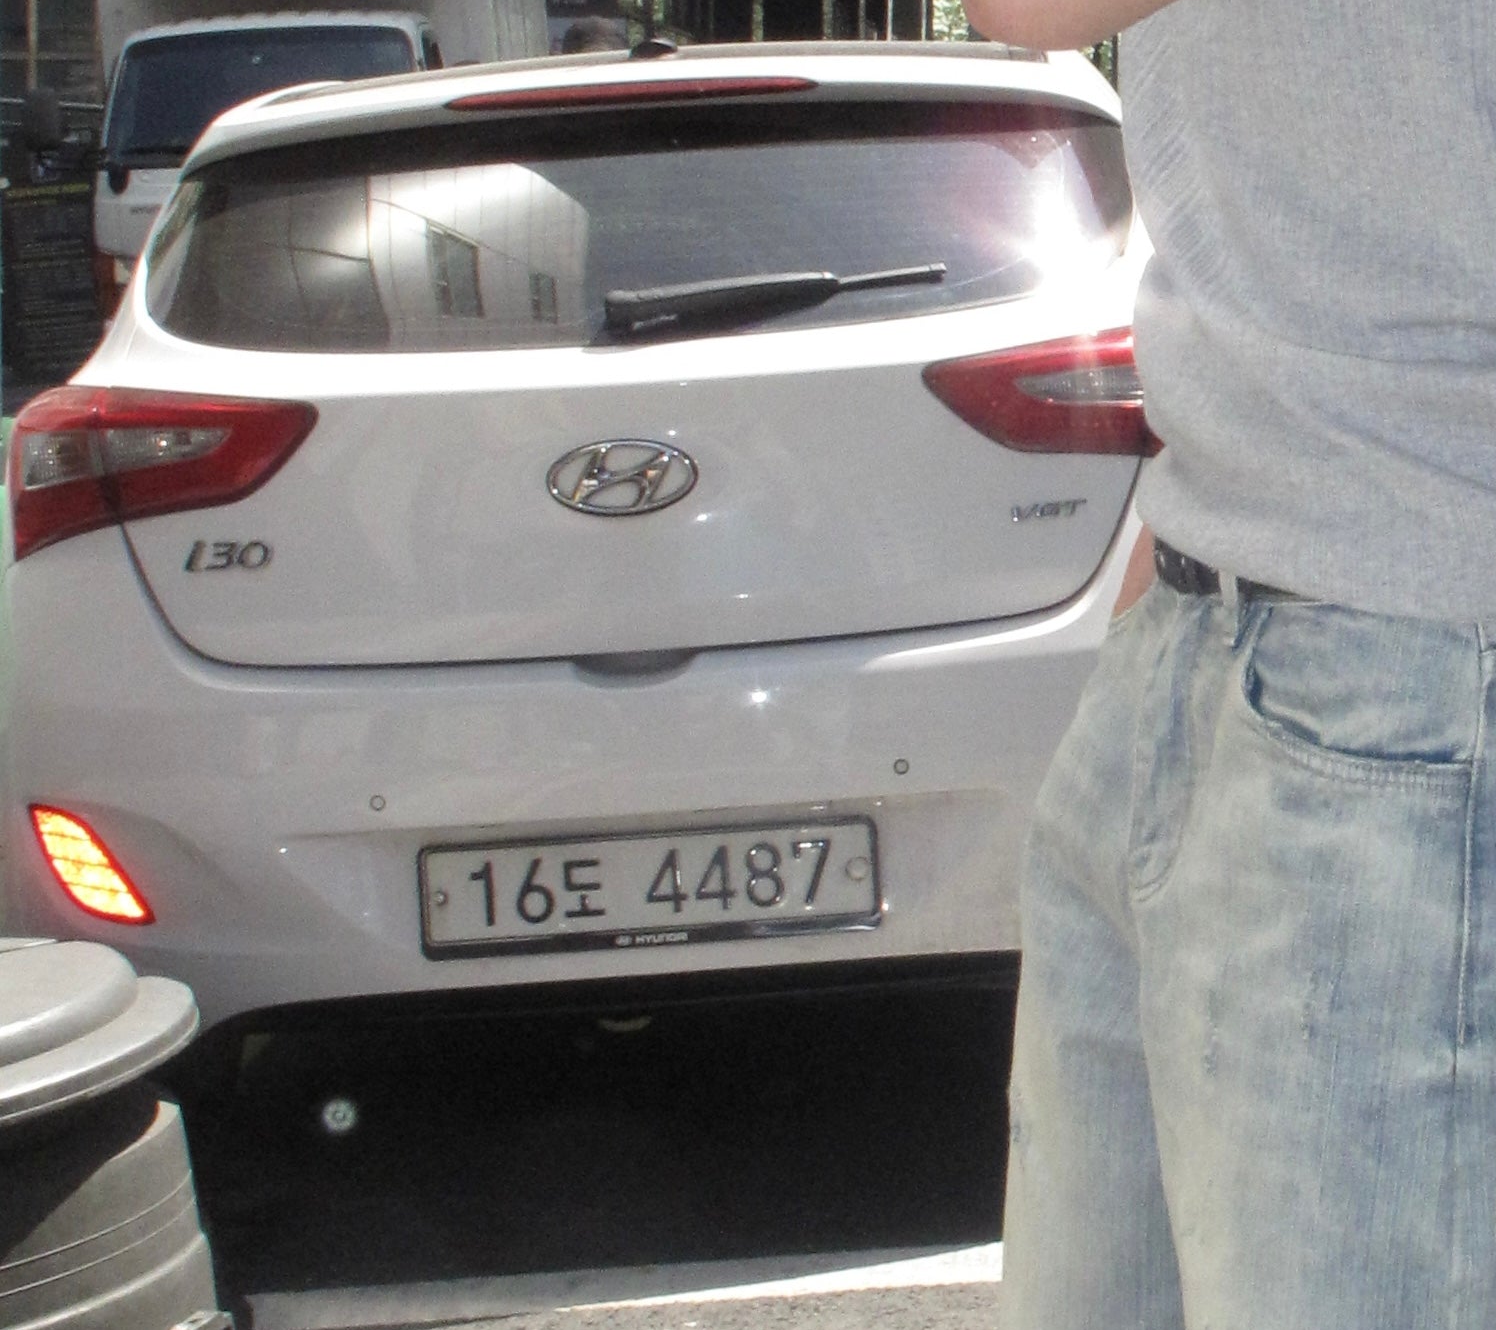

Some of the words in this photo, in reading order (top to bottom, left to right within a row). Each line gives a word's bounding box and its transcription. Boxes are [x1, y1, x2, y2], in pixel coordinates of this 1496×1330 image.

[1010, 498, 1088, 523] VGT
[184, 539, 270, 573] i30
[469, 857, 606, 927] 16도
[646, 838, 832, 914] 4487
